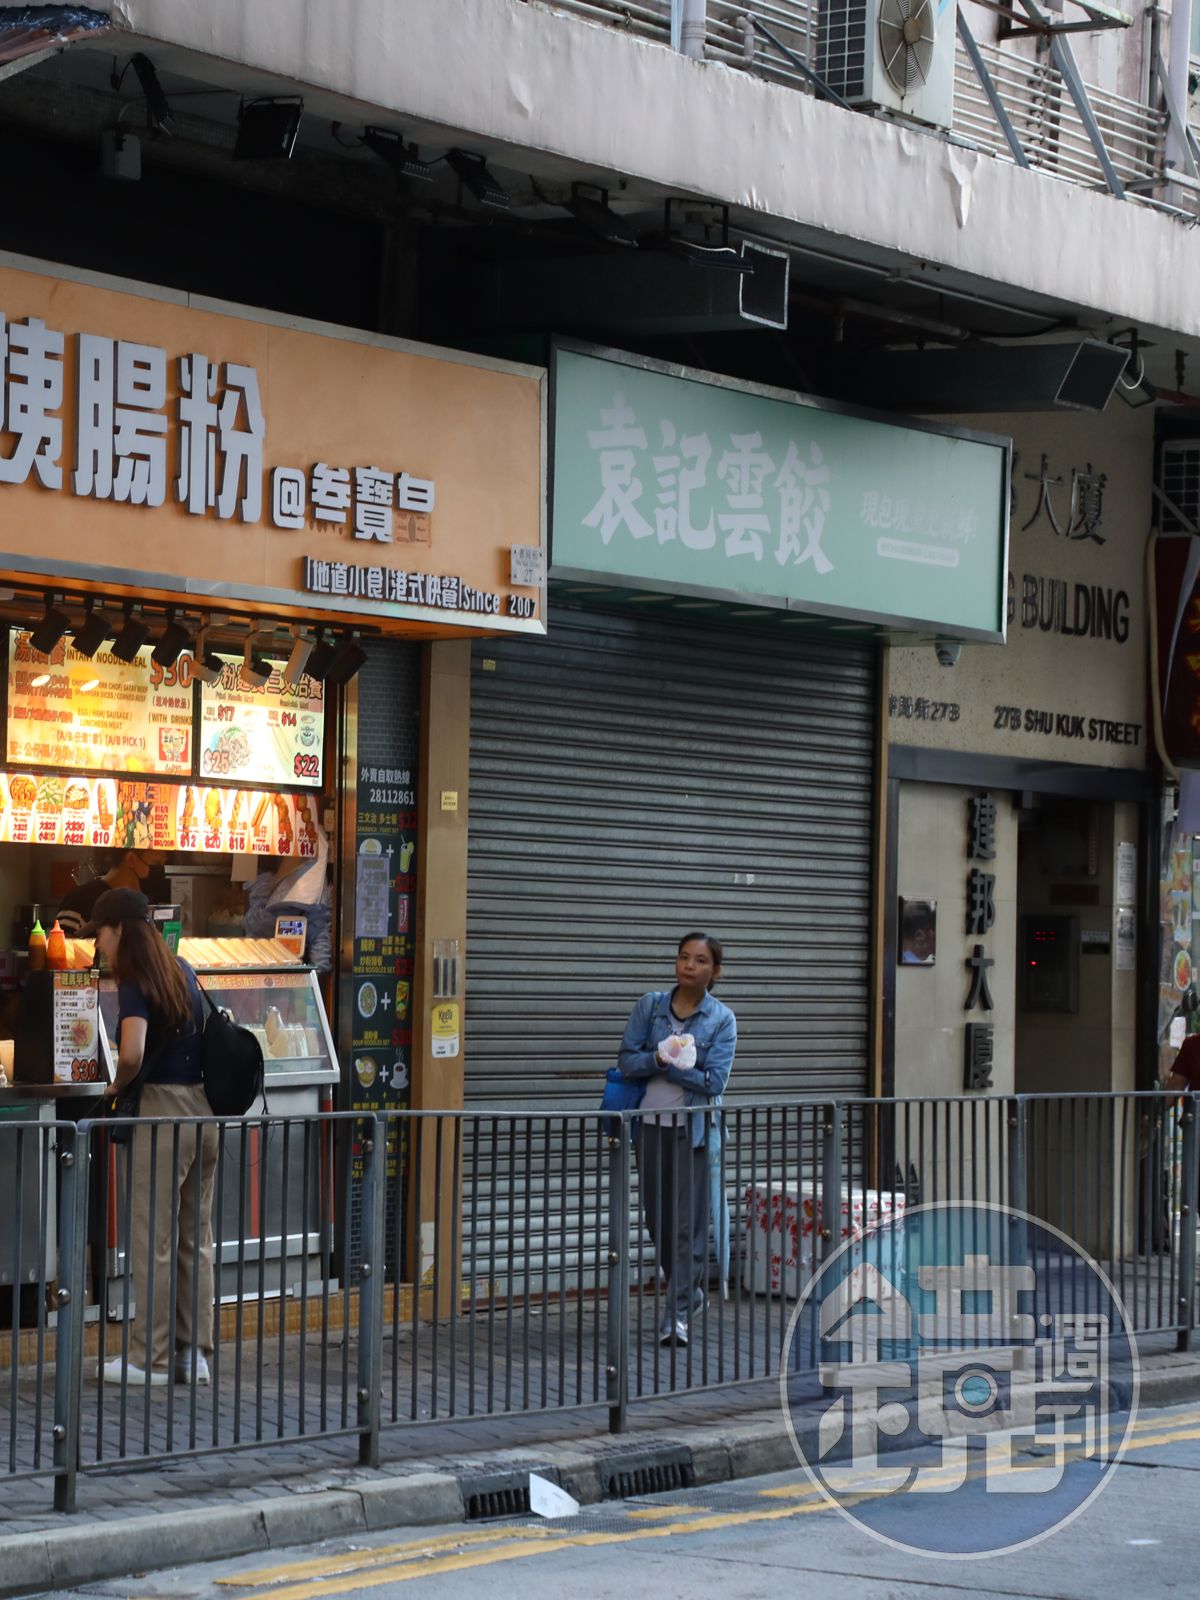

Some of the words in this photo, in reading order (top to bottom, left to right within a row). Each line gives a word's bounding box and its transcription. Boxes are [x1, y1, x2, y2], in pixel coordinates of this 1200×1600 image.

[582, 393, 834, 573] 袁記雲餃
[1010, 451, 1108, 546] 大廈
[523, 568, 533, 583] 27
[510, 596, 537, 618] 2007
[1022, 574, 1130, 645] BUILDING
[993, 705, 1023, 732] 27B
[1024, 709, 1053, 735] SHU
[1056, 714, 1086, 740] KUK
[1088, 718, 1142, 746] STREET
[294, 752, 319, 778] $22
[370, 788, 415, 806] 28112861
[964, 792, 997, 1090] 建邦大廈
[71, 1058, 97, 1082] $30
